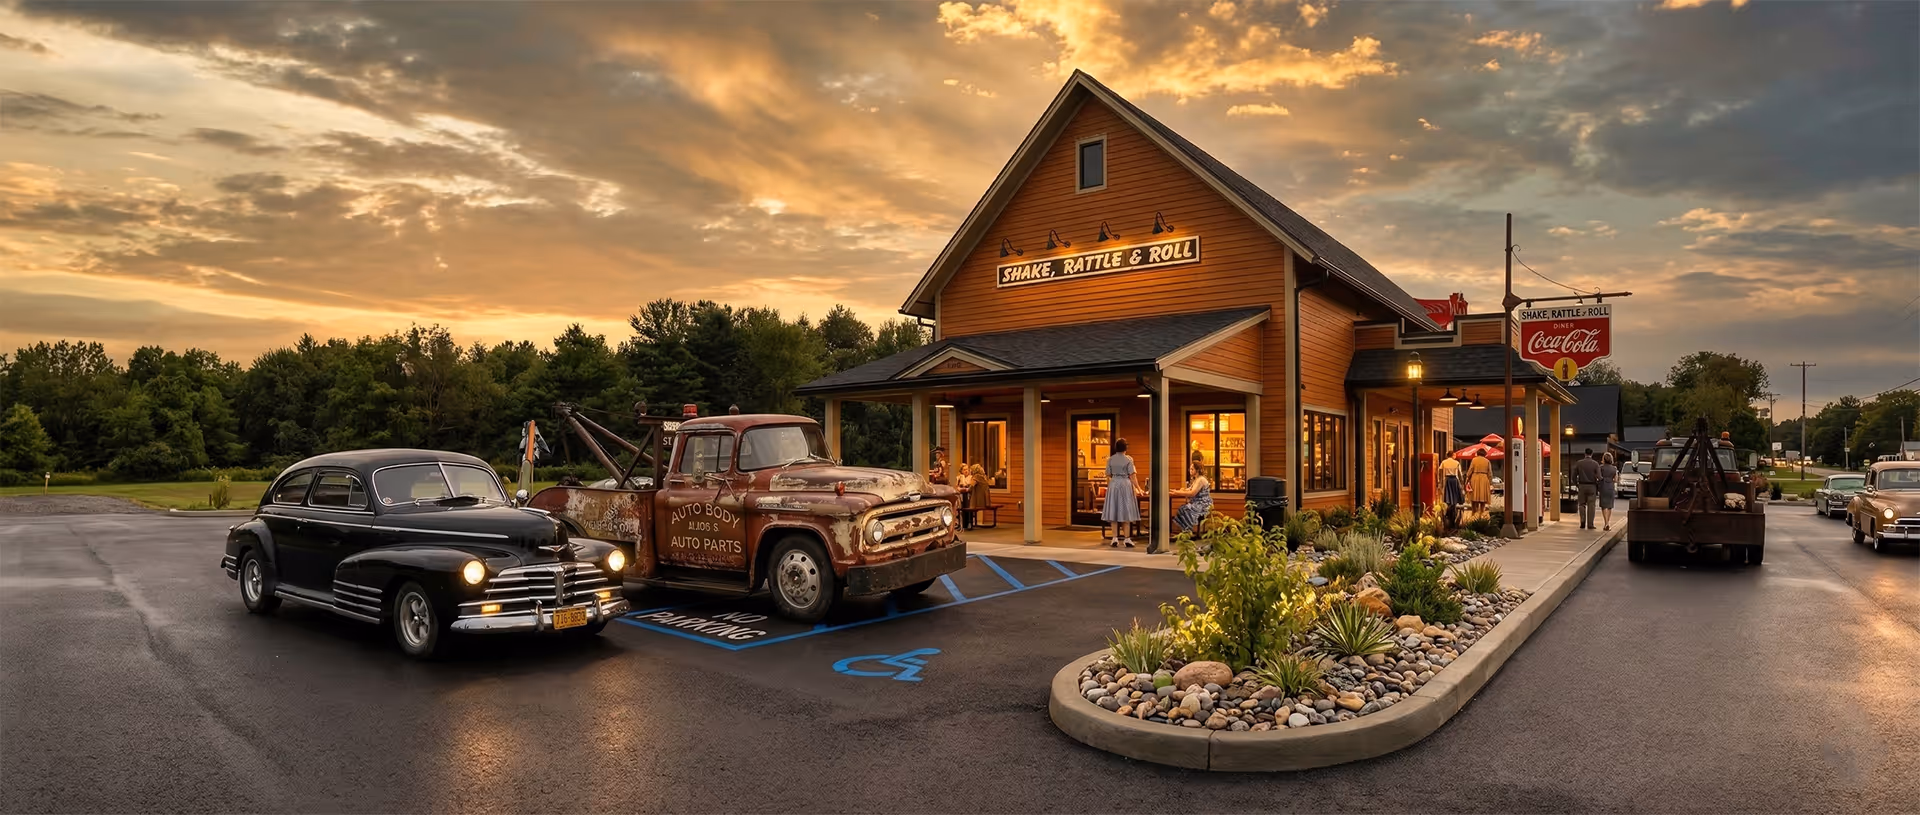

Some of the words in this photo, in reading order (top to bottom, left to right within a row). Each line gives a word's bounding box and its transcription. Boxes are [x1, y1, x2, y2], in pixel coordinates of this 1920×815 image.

[1002, 262, 1056, 283] SHAKE,
[1063, 251, 1122, 274] RATTLE
[1129, 249, 1142, 265] &
[1149, 241, 1193, 263] ROLL
[1521, 310, 1550, 320] SHAKE,
[1551, 308, 1581, 319] RATTLE
[1588, 306, 1609, 316] ROLL
[1527, 328, 1601, 355] Coca-Cola
[671, 502, 702, 525] AUTO
[705, 503, 740, 529] BODY
[670, 536, 701, 550] AUTO
[703, 538, 742, 553] PARTS
[636, 611, 767, 640] PARKING
[711, 611, 768, 624] NO
